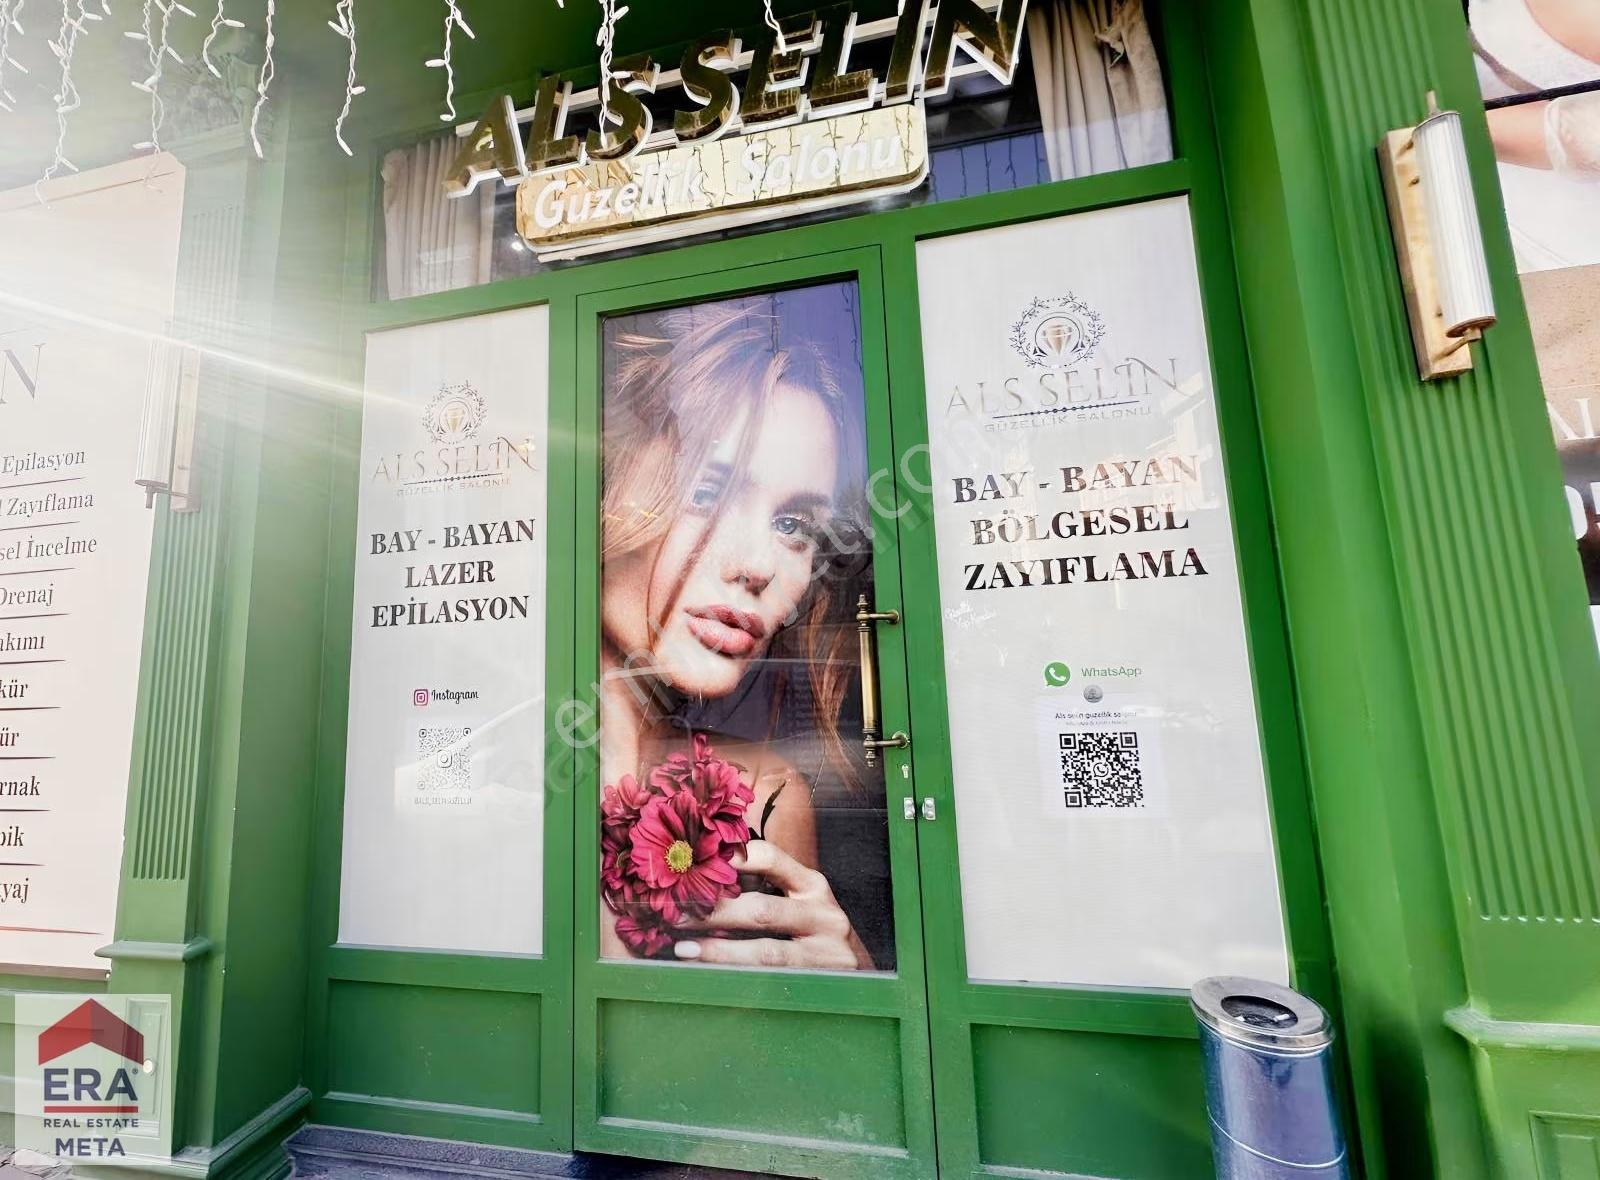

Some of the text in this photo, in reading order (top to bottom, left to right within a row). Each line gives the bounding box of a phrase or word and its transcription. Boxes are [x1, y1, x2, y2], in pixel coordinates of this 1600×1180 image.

[440, 55, 660, 198] ALS
[737, 133, 901, 194] Salonu
[946, 377, 1023, 416] ALS
[1077, 405, 1152, 420] SALONU
[2, 451, 86, 476] Epilasyon
[951, 471, 1028, 503] BAY
[1060, 455, 1198, 494] BAYAN
[7, 493, 94, 518] Zayıflama
[370, 529, 423, 555] BAY
[443, 519, 536, 549] BAYAN
[970, 502, 1190, 546] BÖLGESEL
[27, 535, 97, 559] İncelme
[404, 560, 496, 588] LAZER
[964, 547, 1208, 591] ZAYIFLAMA
[371, 596, 529, 628] EPİLASYON
[1081, 666, 1142, 678] WhatsApp
[431, 689, 479, 705] Instagram
[0, 877, 29, 904] yaj
